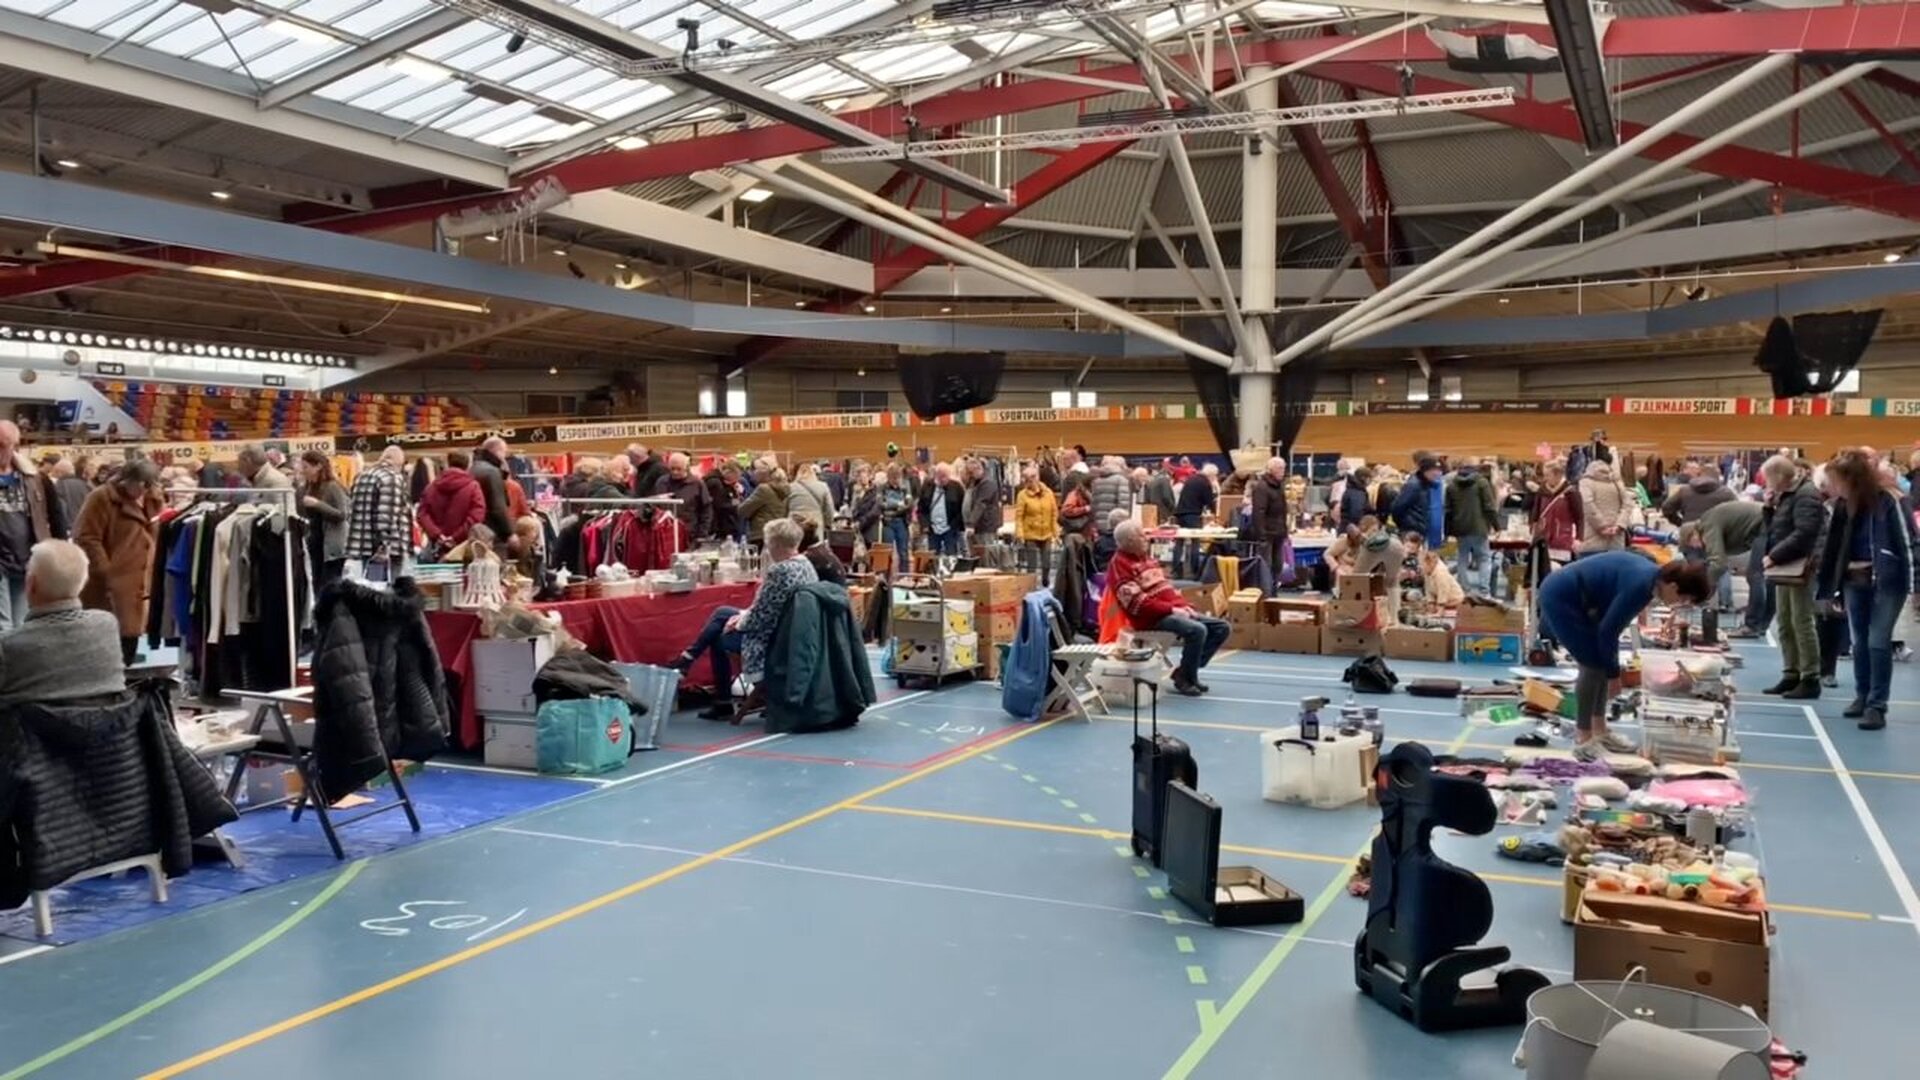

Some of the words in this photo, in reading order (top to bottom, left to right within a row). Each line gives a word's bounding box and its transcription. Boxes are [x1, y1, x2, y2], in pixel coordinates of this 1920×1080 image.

[1693, 401, 1727, 412] SPORT
[1000, 409, 1057, 421] SPORTPALEIS
[568, 426, 626, 439] SPORTCOMPLEX
[627, 426, 637, 436] DE
[674, 423, 731, 435] SPORTCOMPLEX
[733, 422, 743, 432] DE
[296, 441, 330, 452] IVECO
